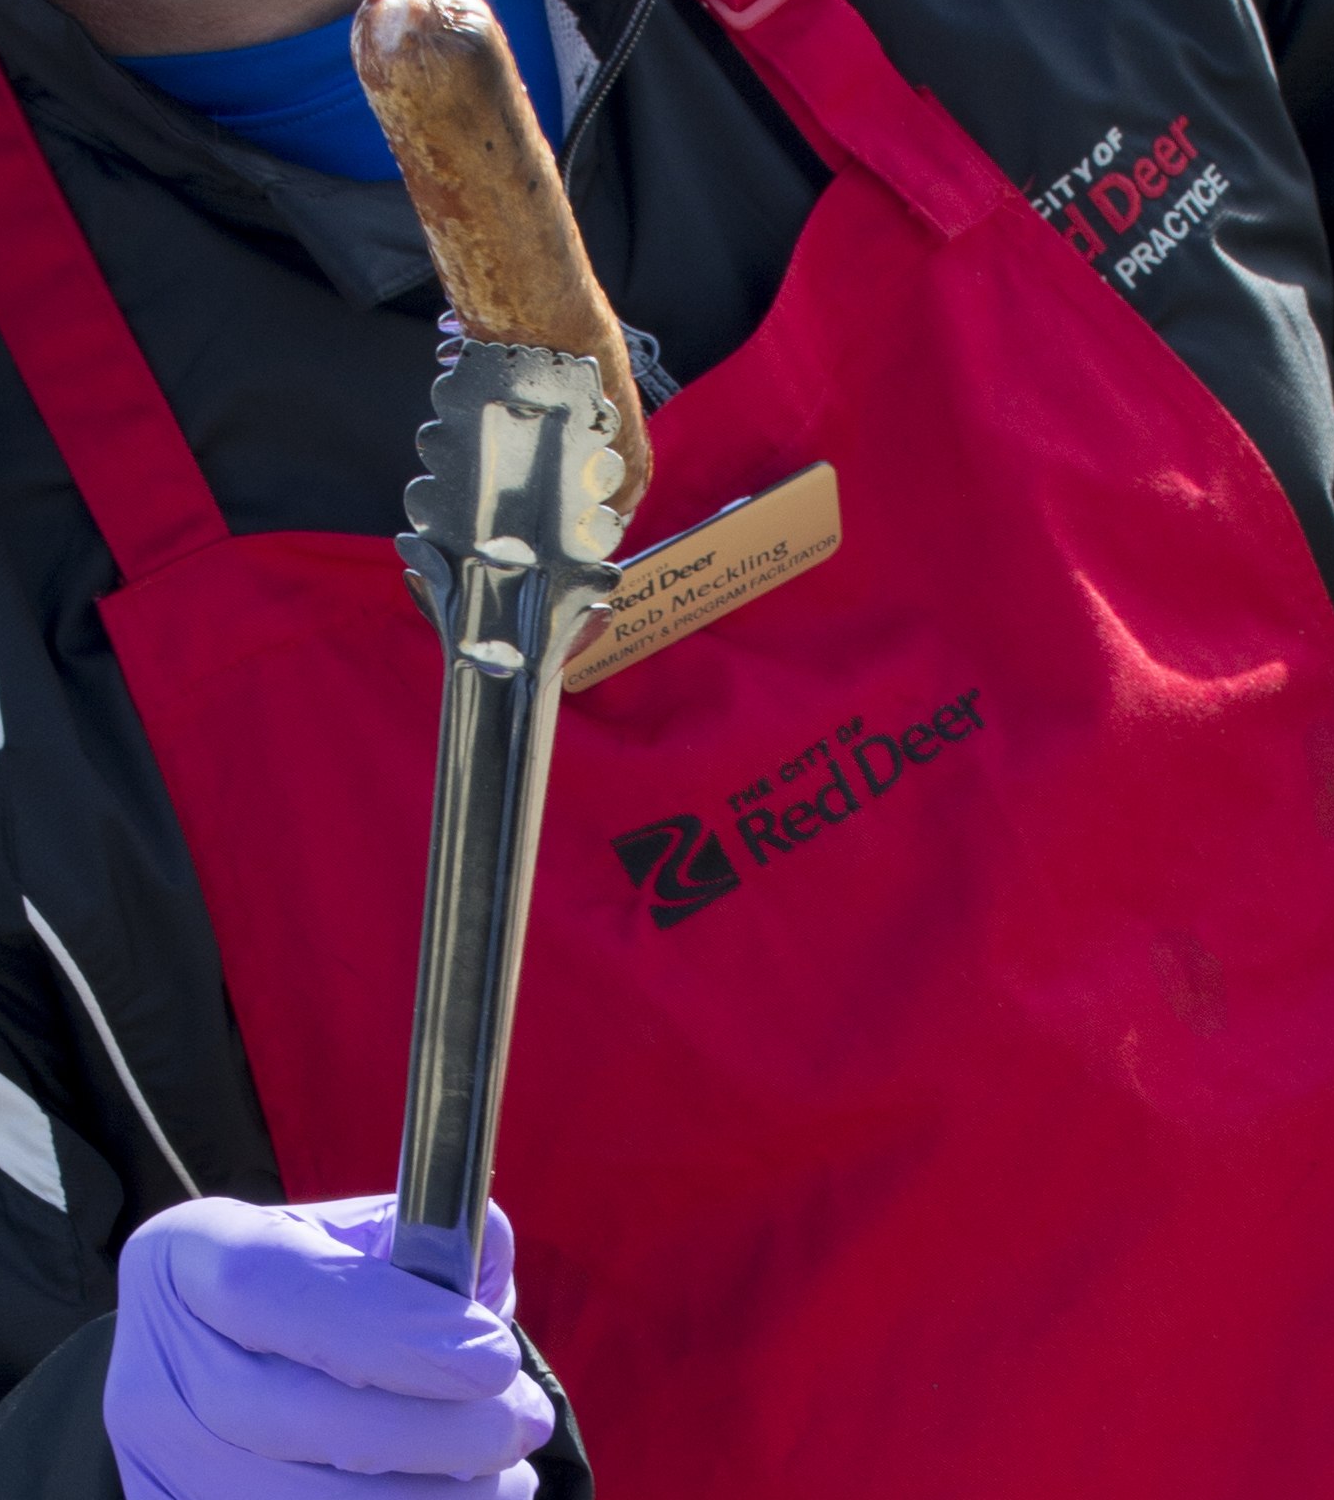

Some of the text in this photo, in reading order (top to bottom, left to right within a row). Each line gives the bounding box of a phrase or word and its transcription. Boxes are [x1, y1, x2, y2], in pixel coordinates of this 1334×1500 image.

[1087, 114, 1198, 235] Deer
[1093, 127, 1123, 167] OF
[1115, 163, 1230, 289] PRACTICE
[568, 534, 837, 686] COMMUNITY & PROGRAM FACILITATOR
[608, 551, 716, 613] Red Deer
[616, 540, 788, 641] Rob Meckling
[737, 687, 986, 866] Red Deer
[779, 739, 831, 783] CITY
